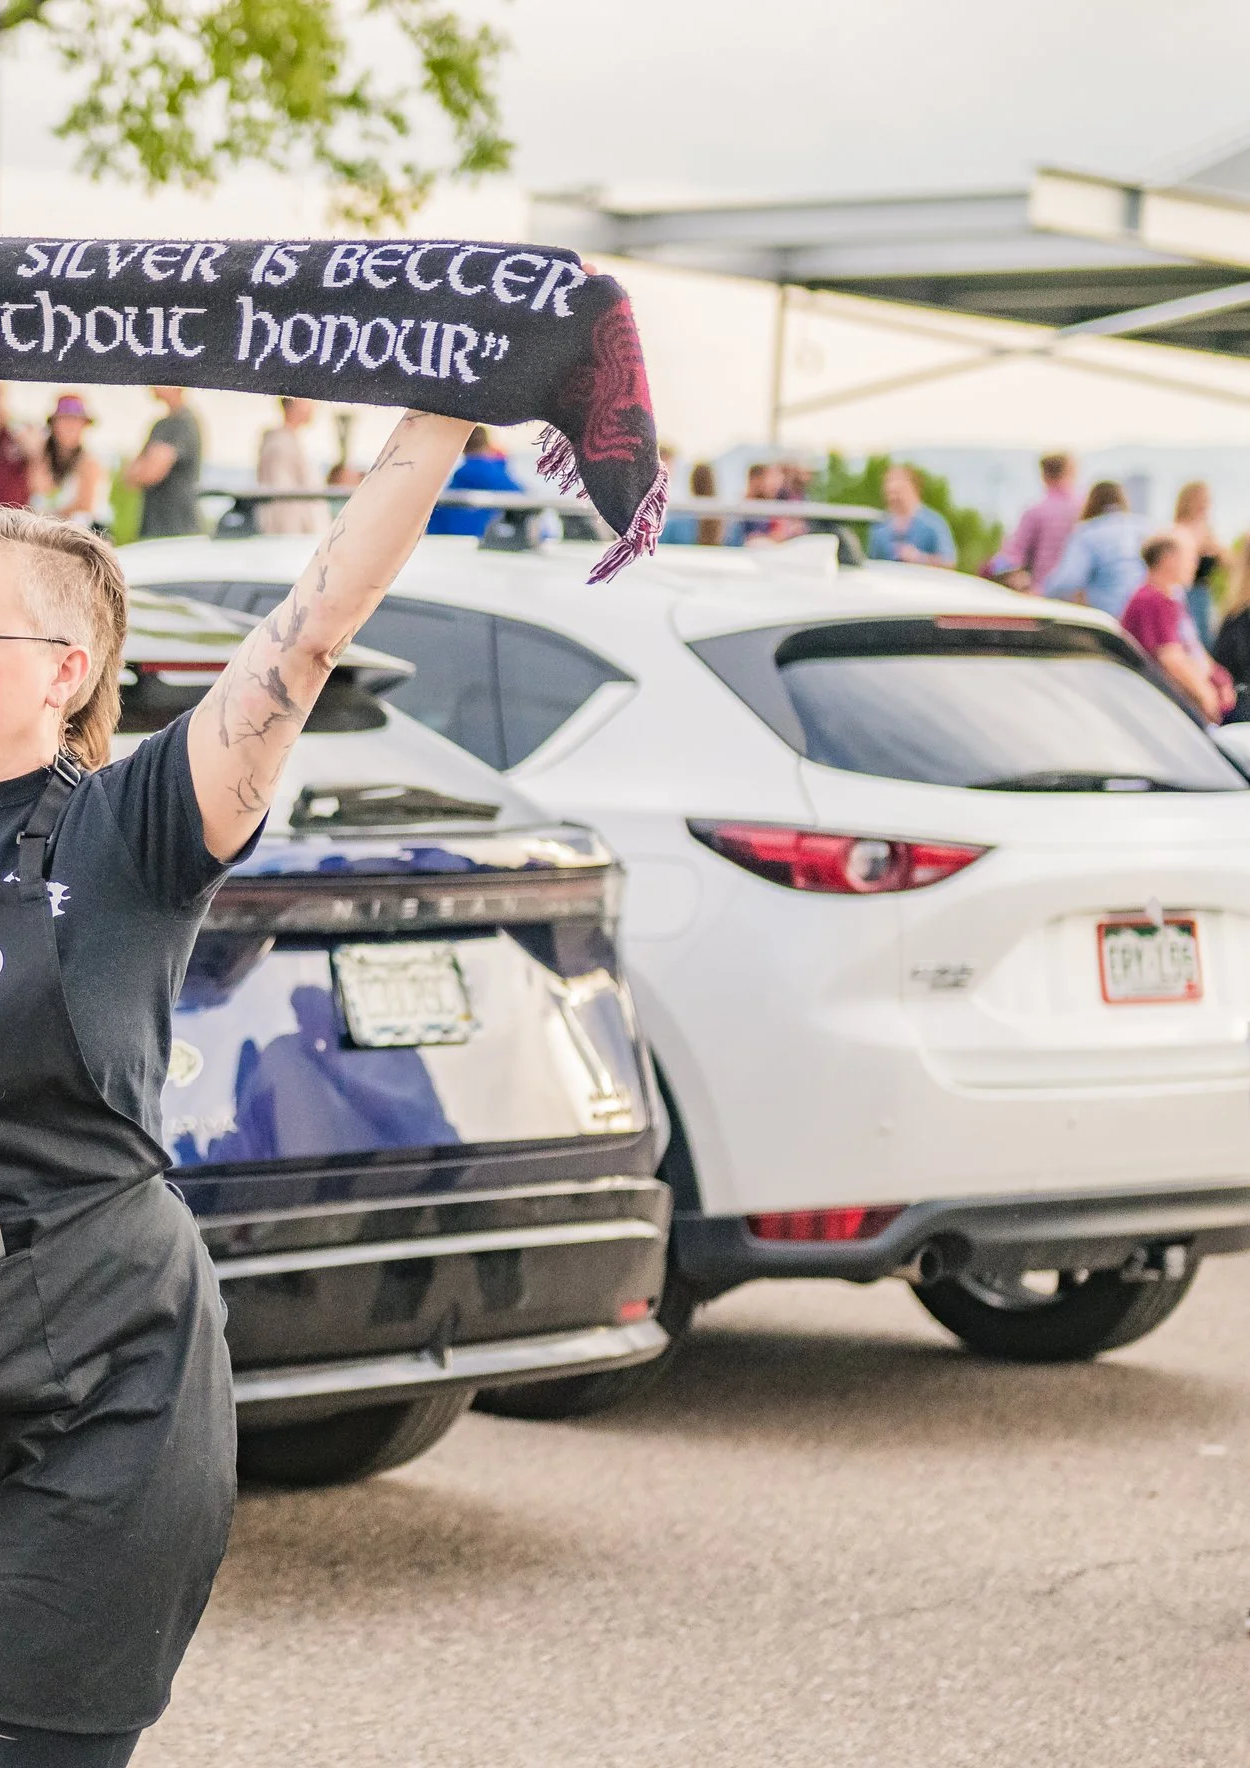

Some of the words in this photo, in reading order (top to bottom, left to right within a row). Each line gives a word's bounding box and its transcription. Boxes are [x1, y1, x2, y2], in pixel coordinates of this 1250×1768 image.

[16, 241, 228, 282] SILVER
[249, 241, 311, 287] IS
[322, 243, 588, 318] BETTER
